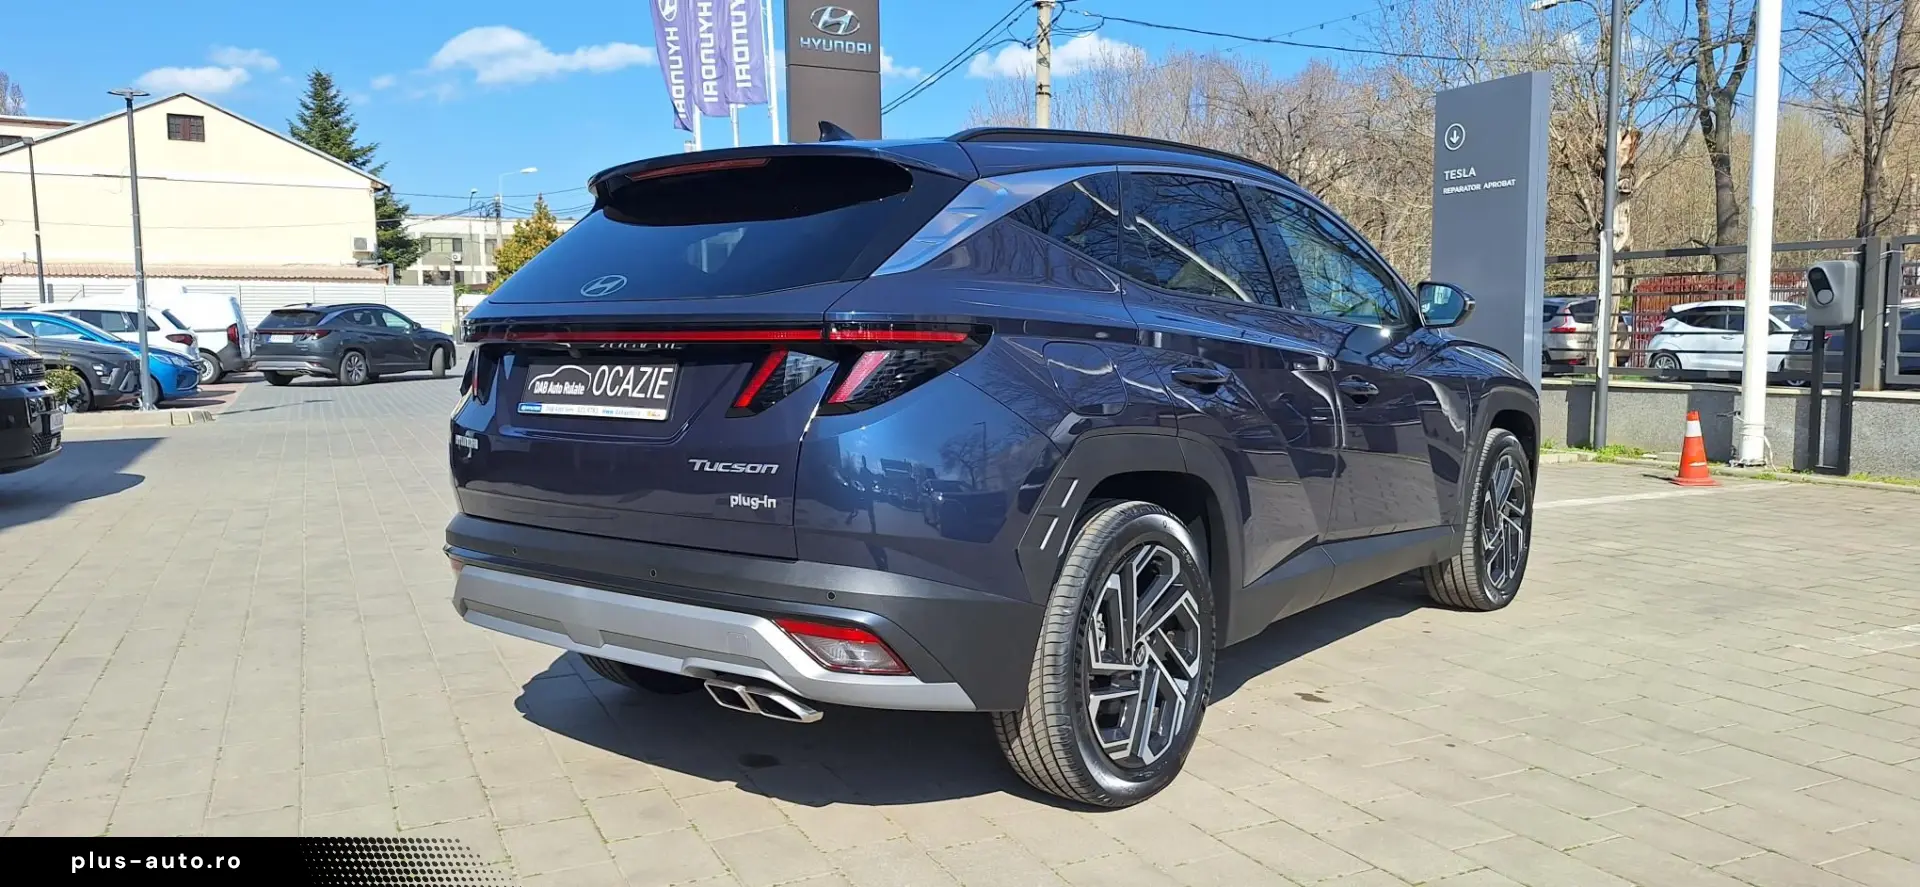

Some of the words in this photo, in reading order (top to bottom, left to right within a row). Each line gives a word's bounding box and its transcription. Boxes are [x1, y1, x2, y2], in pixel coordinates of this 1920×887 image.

[800, 36, 872, 54] HYUNDAI
[1443, 166, 1477, 181] TESLA
[1442, 183, 1481, 195] REPARATOR
[1483, 178, 1517, 189] APROBAT
[533, 381, 548, 394] DAB
[547, 382, 562, 394] Auto
[592, 365, 674, 399] OCAZIE
[729, 493, 777, 510] plug-in
